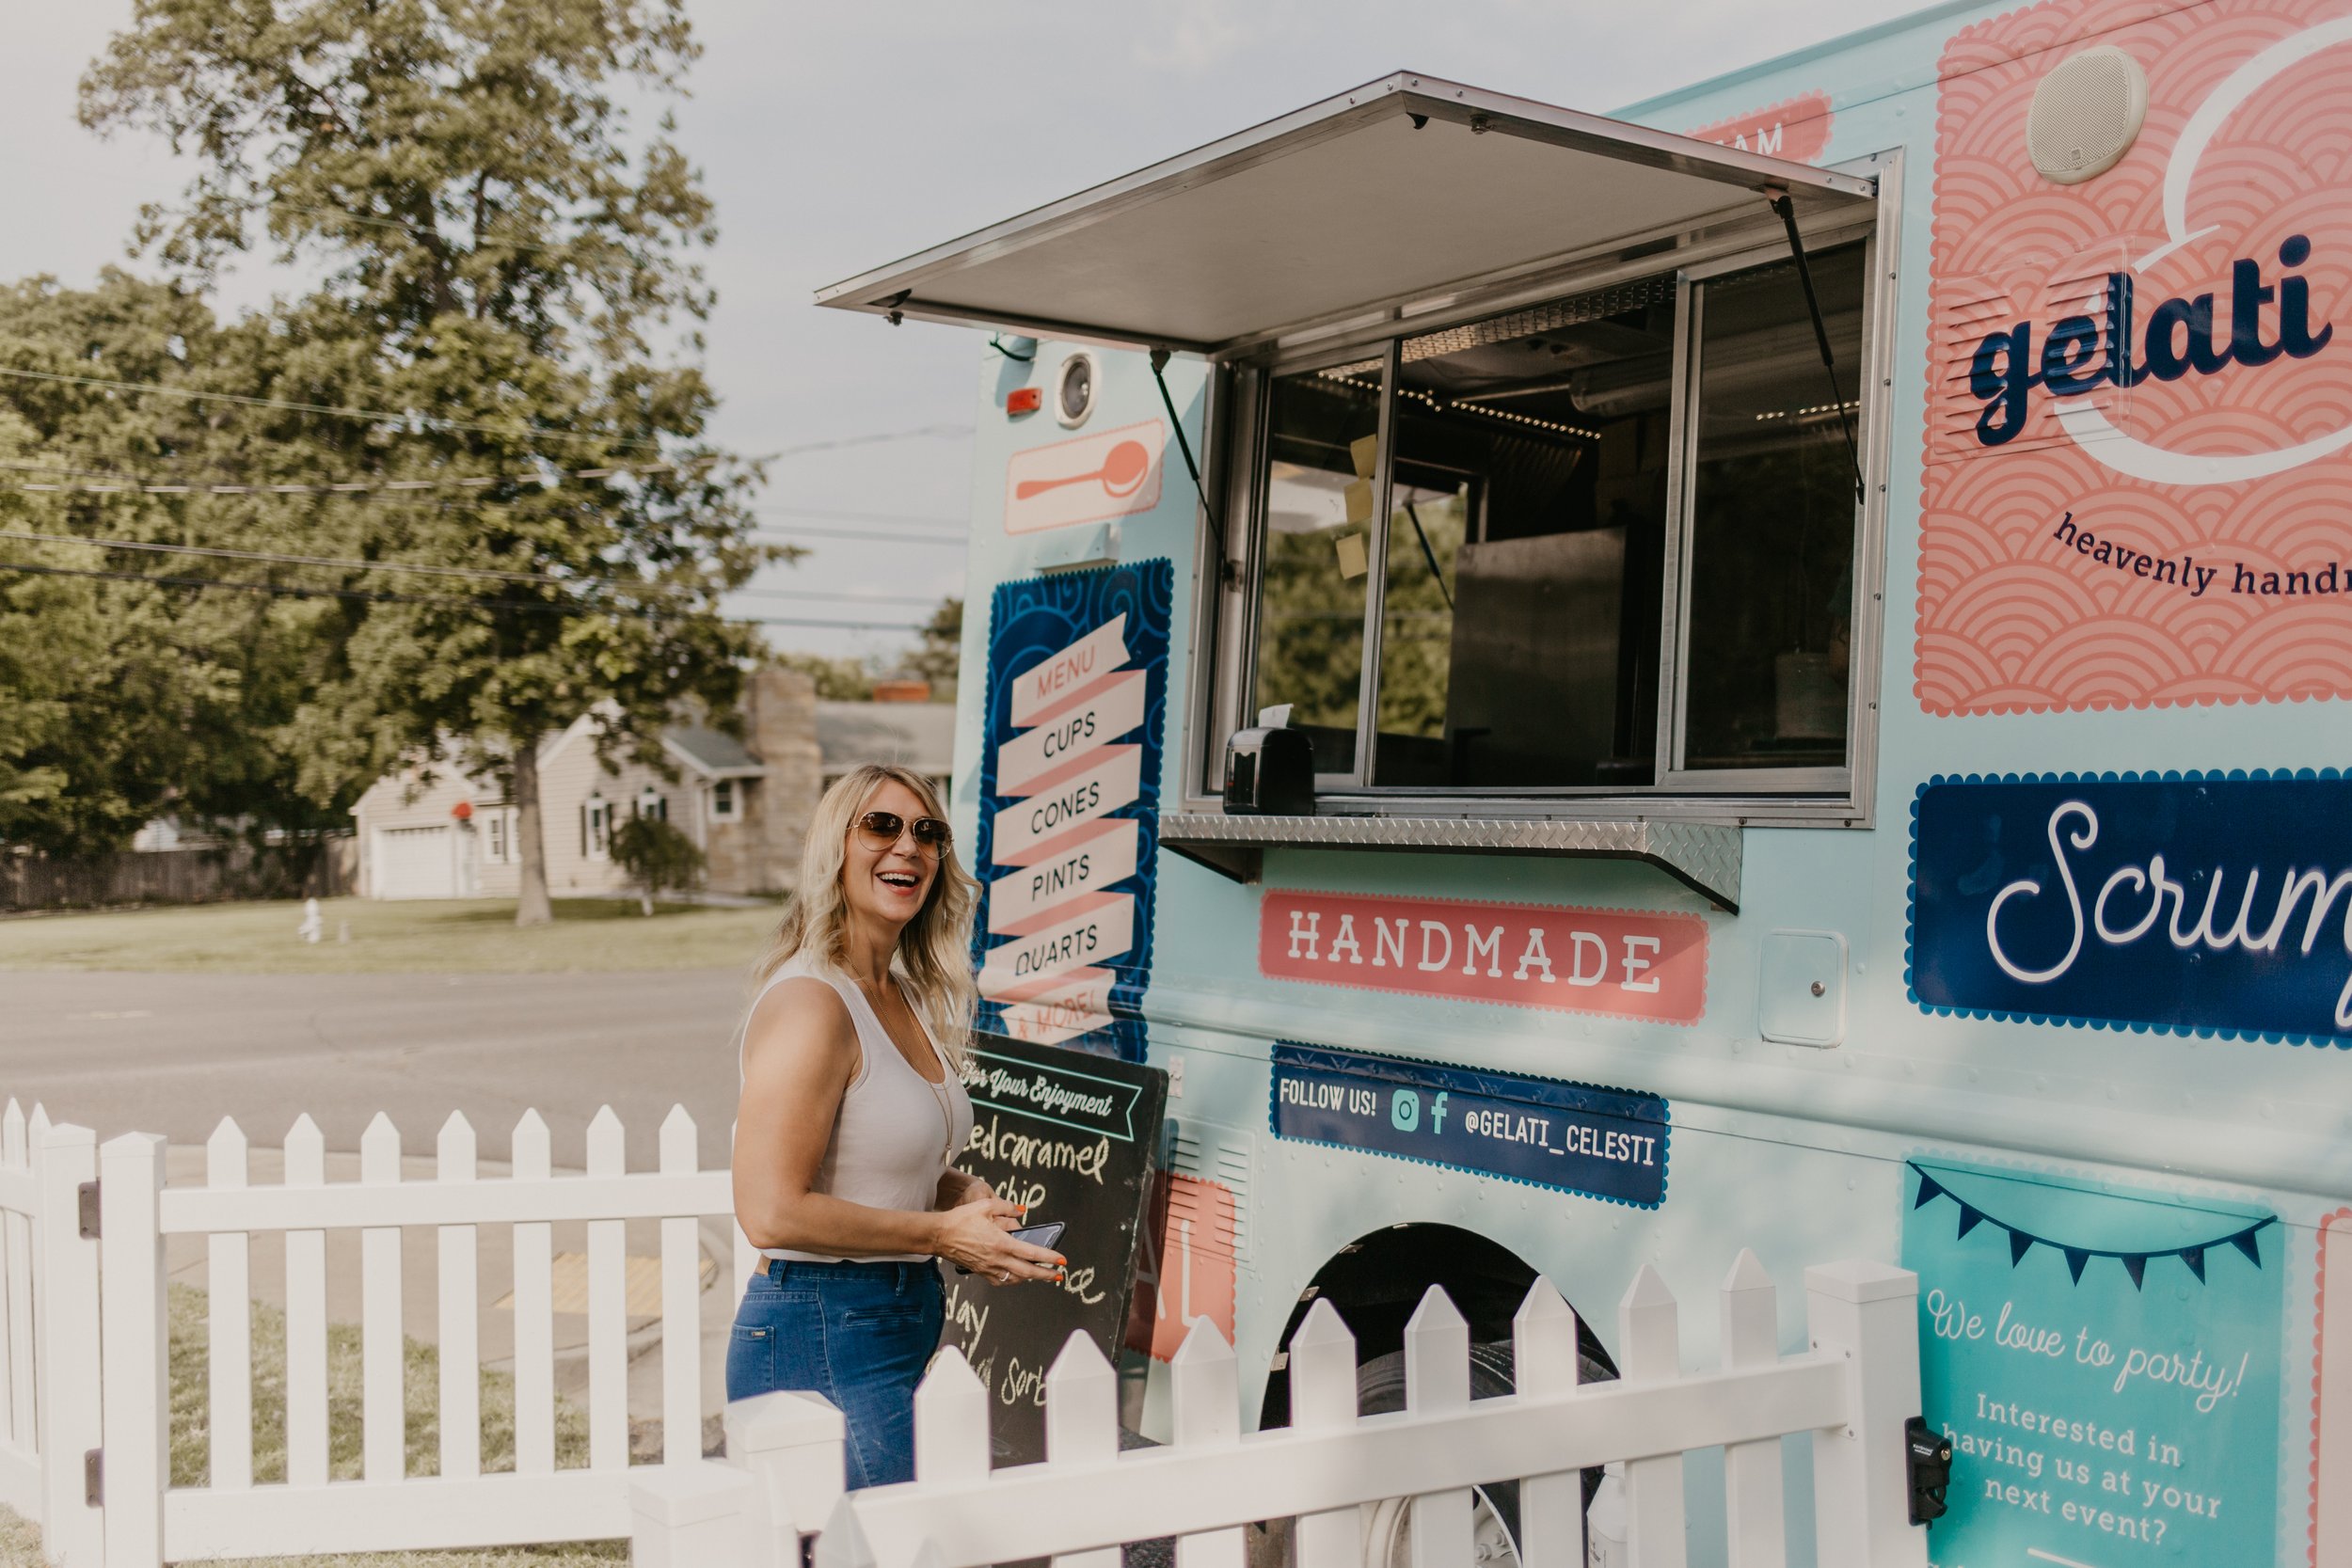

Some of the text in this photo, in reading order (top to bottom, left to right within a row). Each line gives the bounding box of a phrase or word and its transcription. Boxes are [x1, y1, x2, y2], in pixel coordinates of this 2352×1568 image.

[1968, 234, 2333, 447] gelati
[2053, 511, 2218, 597] heavenly
[1037, 644, 1096, 701] MENU
[1043, 711, 1096, 759] CUPS
[1031, 781, 1100, 835] CONES
[1032, 853, 1090, 902] PINTS
[1015, 924, 1098, 976] QUARTS
[1287, 910, 1661, 994] HANDMADE
[990, 1068, 1029, 1099] Your
[1029, 1074, 1114, 1117] Enjoyment
[1279, 1078, 1345, 1112] FOLLOW
[1348, 1087, 1377, 1117] US!
[1465, 1110, 1656, 1166] @GELATI_CELESTI
[946, 1283, 990, 1365] day
[1927, 1289, 2250, 1413] We love to party!
[1001, 1357, 1048, 1406] Sorb
[1977, 1394, 2182, 1467] Interested in
[1942, 1423, 2044, 1478] having
[2056, 1458, 2090, 1486] us
[2102, 1467, 2132, 1497] at
[2142, 1479, 2221, 1519] your
[1985, 1476, 2168, 1545] next event?
